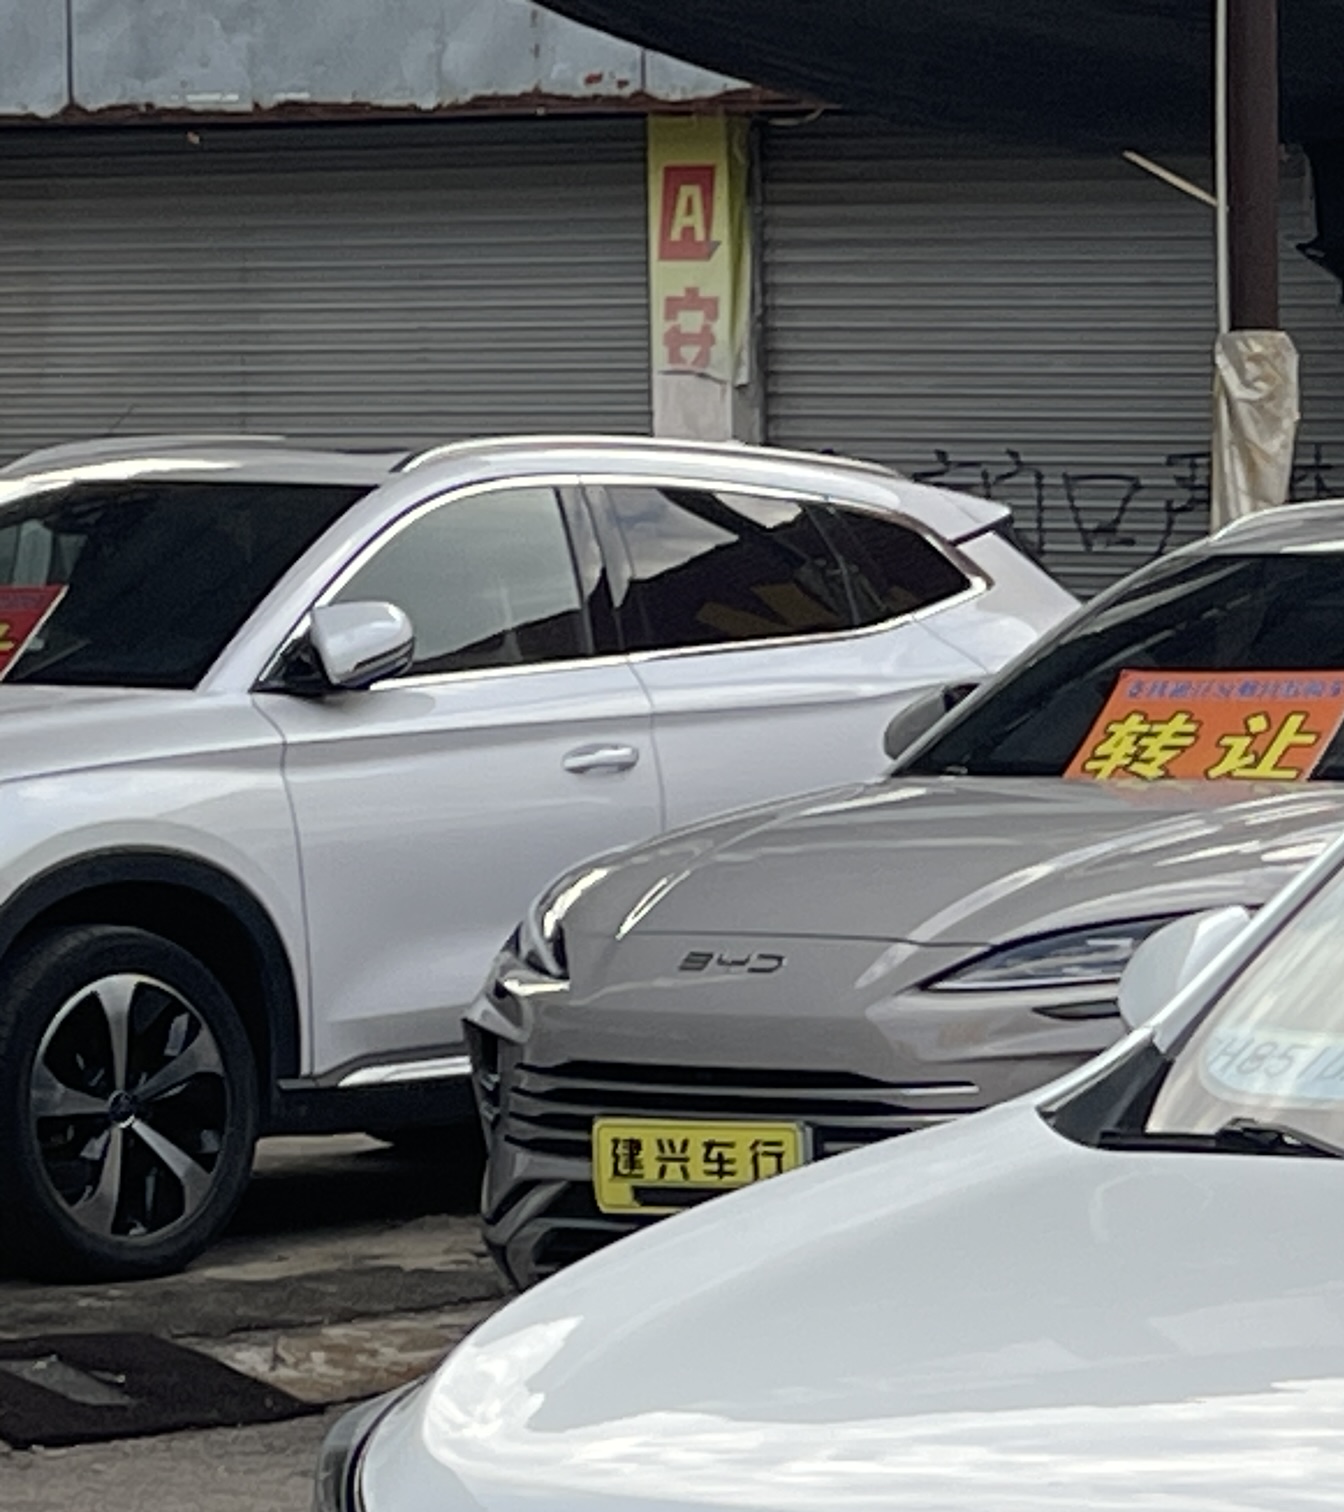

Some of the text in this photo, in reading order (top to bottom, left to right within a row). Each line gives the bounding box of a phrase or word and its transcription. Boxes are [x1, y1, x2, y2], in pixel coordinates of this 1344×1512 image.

[1082, 711, 1318, 780] 转让
[678, 950, 785, 974] BYD
[610, 1137, 786, 1181] 建兴车行
